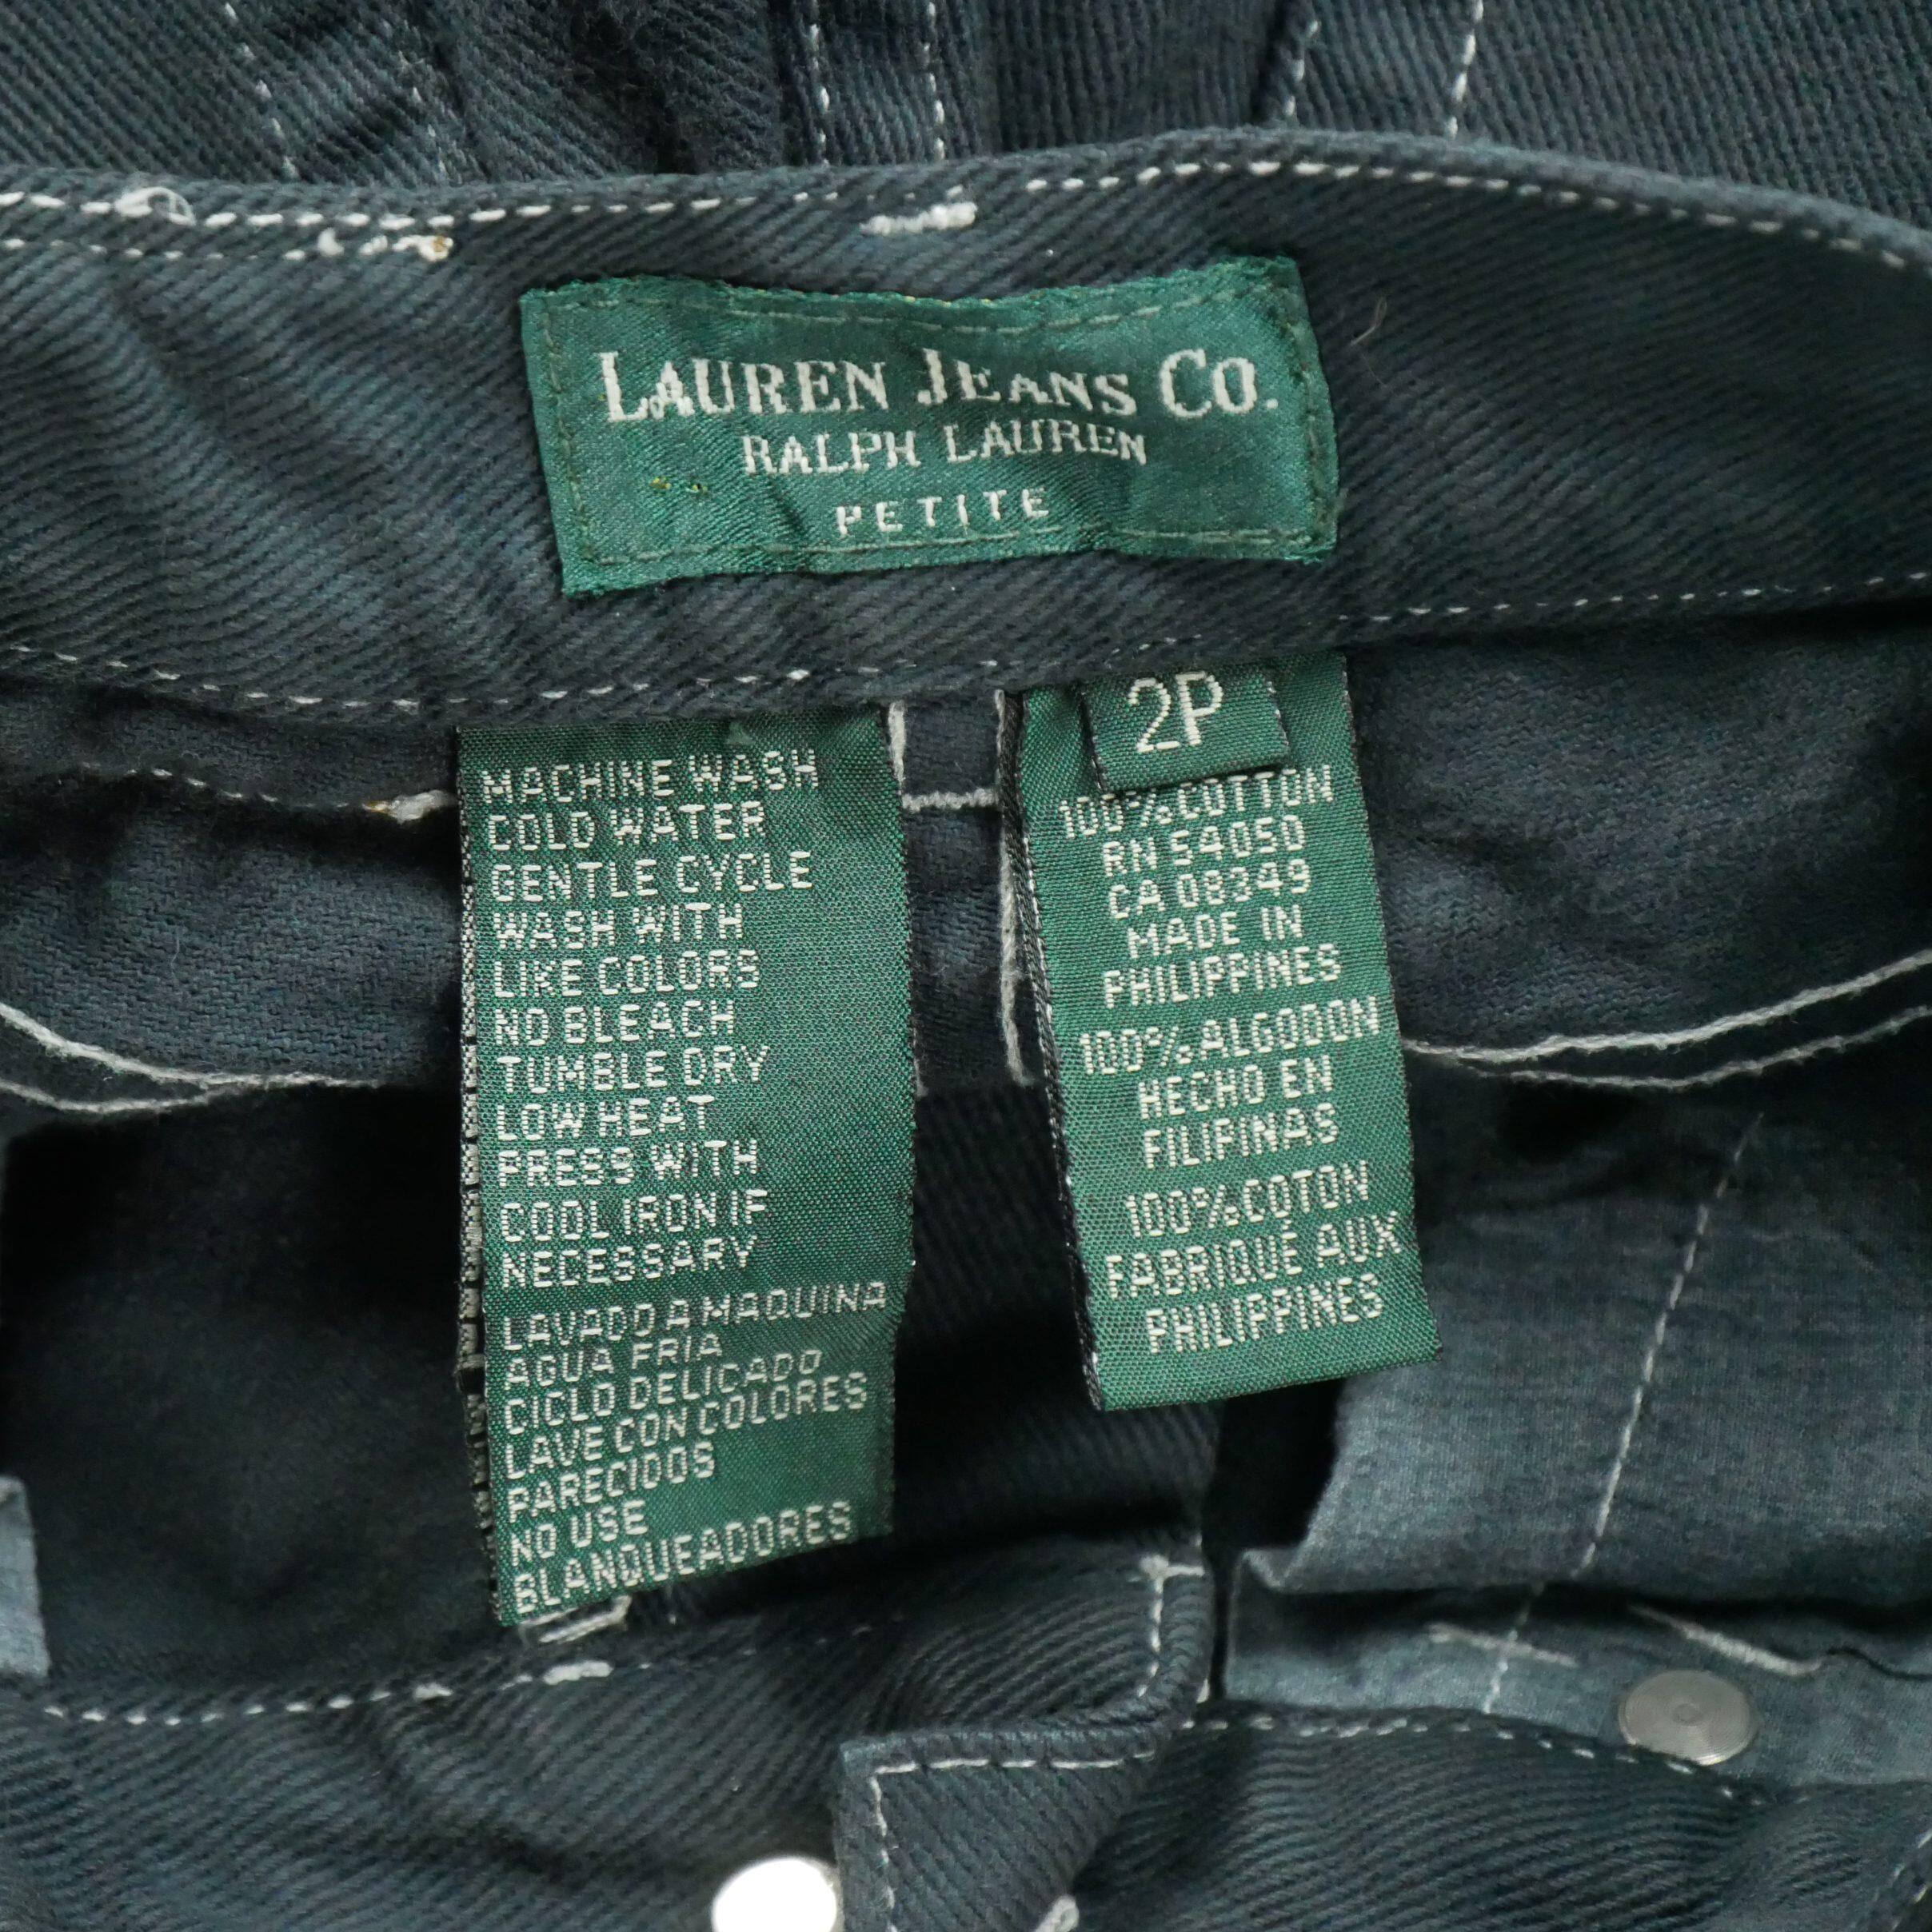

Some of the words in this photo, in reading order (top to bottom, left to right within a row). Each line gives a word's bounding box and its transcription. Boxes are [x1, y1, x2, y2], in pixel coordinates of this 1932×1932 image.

[596, 350, 888, 423] LAUREN
[742, 430, 920, 476] RALPH
[947, 419, 1147, 465] LAUREN
[836, 488, 1050, 537] PETITE
[1128, 670, 1223, 752] 2P
[482, 760, 675, 804] MACHINE
[689, 749, 819, 792] WASH
[488, 812, 595, 851] COLD
[610, 800, 766, 845] WATER
[1103, 837, 1157, 877] RN
[1171, 814, 1306, 866] 54050
[491, 859, 658, 902] GENTLE
[677, 851, 812, 892] CYCLE
[1109, 880, 1166, 919] CA
[1177, 859, 1311, 908] 08349
[493, 910, 615, 950] WASH
[633, 903, 743, 944] WITH
[1128, 911, 1240, 959] MADE
[1262, 904, 1303, 942] IN
[495, 960, 582, 998] LIKE
[599, 949, 760, 996] COLORS
[1104, 944, 1341, 1009] PHILIPPINES
[495, 1008, 549, 1046] NO
[565, 1000, 734, 1045] BLEACH
[497, 1050, 669, 1094] TUMBLE
[684, 1045, 769, 1087] DRY
[1138, 1064, 1265, 1120] HECHO
[1281, 1054, 1334, 1099] EN
[497, 1102, 585, 1141] LOW
[599, 1095, 715, 1138] HEAT
[1143, 1102, 1338, 1169] FILIPINAS
[498, 1147, 634, 1187] PRESS
[652, 1139, 758, 1180] WITH
[502, 1200, 610, 1243] COOL
[625, 1192, 717, 1235] IRON
[732, 1189, 768, 1226] IF
[1317, 1211, 1401, 1269] AUX
[502, 1235, 758, 1288] NECESSARY
[504, 1303, 655, 1351] LAVADO
[666, 1299, 689, 1331] A
[703, 1282, 886, 1327] MAQUINA
[1146, 1273, 1383, 1354] PHILIPPINES
[504, 1348, 613, 1390] AGUA
[632, 1333, 722, 1370] FRIA
[505, 1383, 615, 1435] CICLO
[630, 1349, 820, 1410] DELICADO
[507, 1427, 603, 1479] LAVE
[615, 1407, 687, 1453] CON
[698, 1371, 867, 1435] COLORES
[508, 1441, 716, 1523] PARECIDOS
[510, 1523, 557, 1567] NO
[571, 1499, 648, 1547] USE
[513, 1501, 852, 1615] BLANQUEADORES
